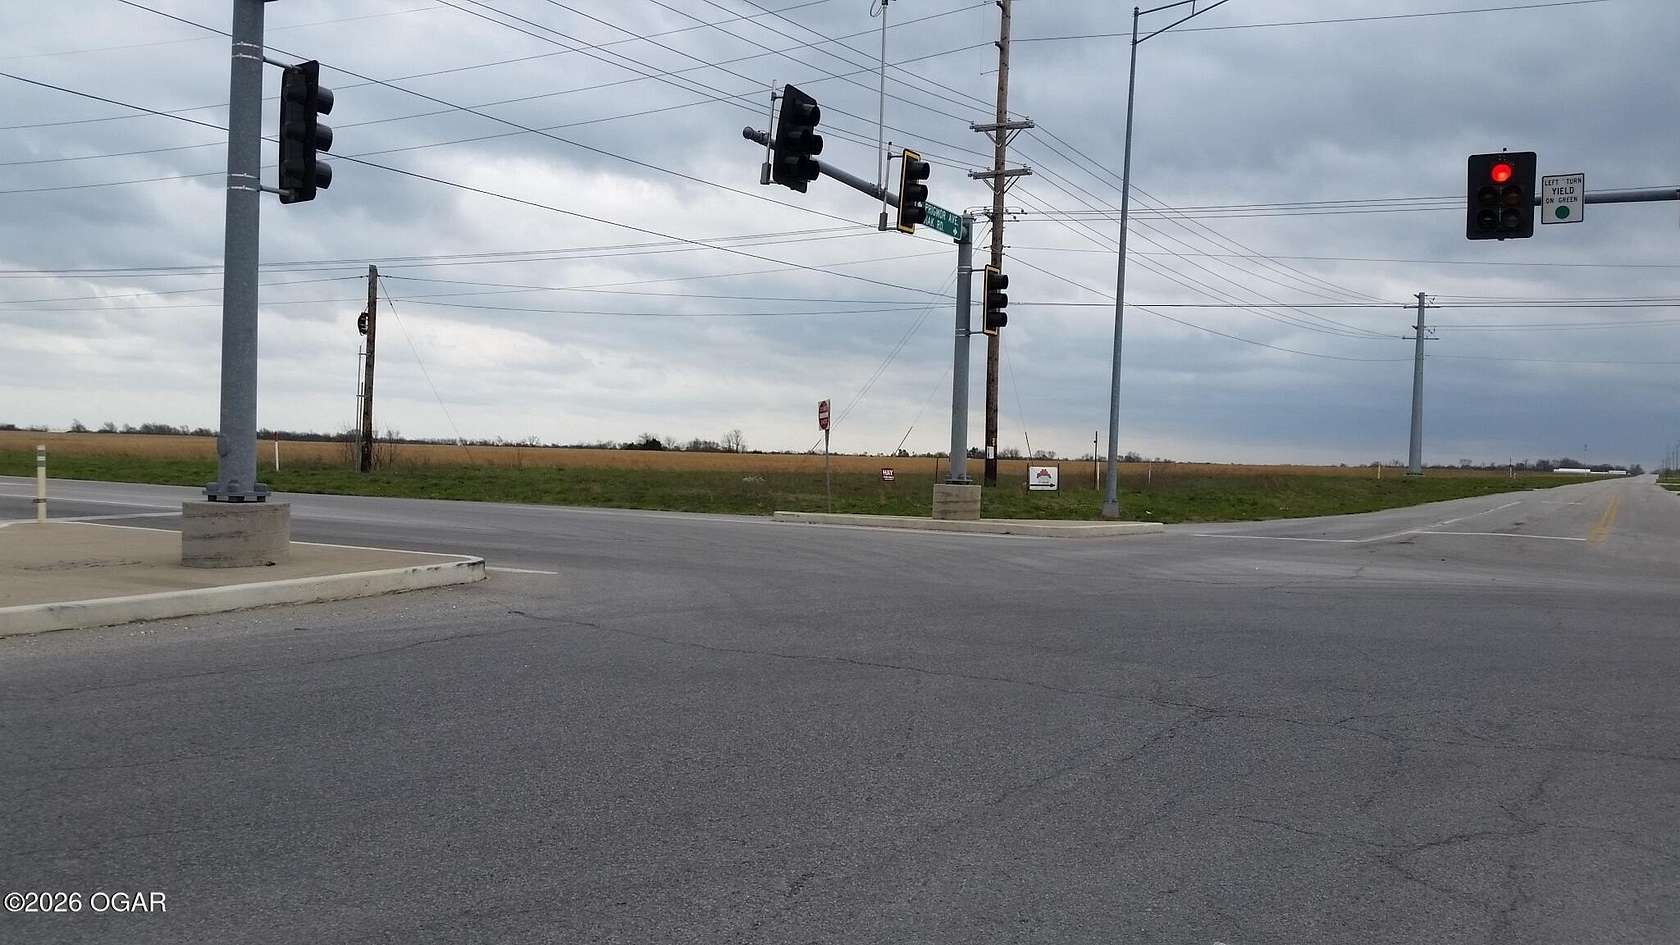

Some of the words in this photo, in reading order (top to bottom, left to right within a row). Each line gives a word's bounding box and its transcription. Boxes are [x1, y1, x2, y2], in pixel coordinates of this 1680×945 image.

[1566, 177, 1582, 185] TURN
[1552, 187, 1575, 195] YIELD
[948, 212, 959, 227] AVE
